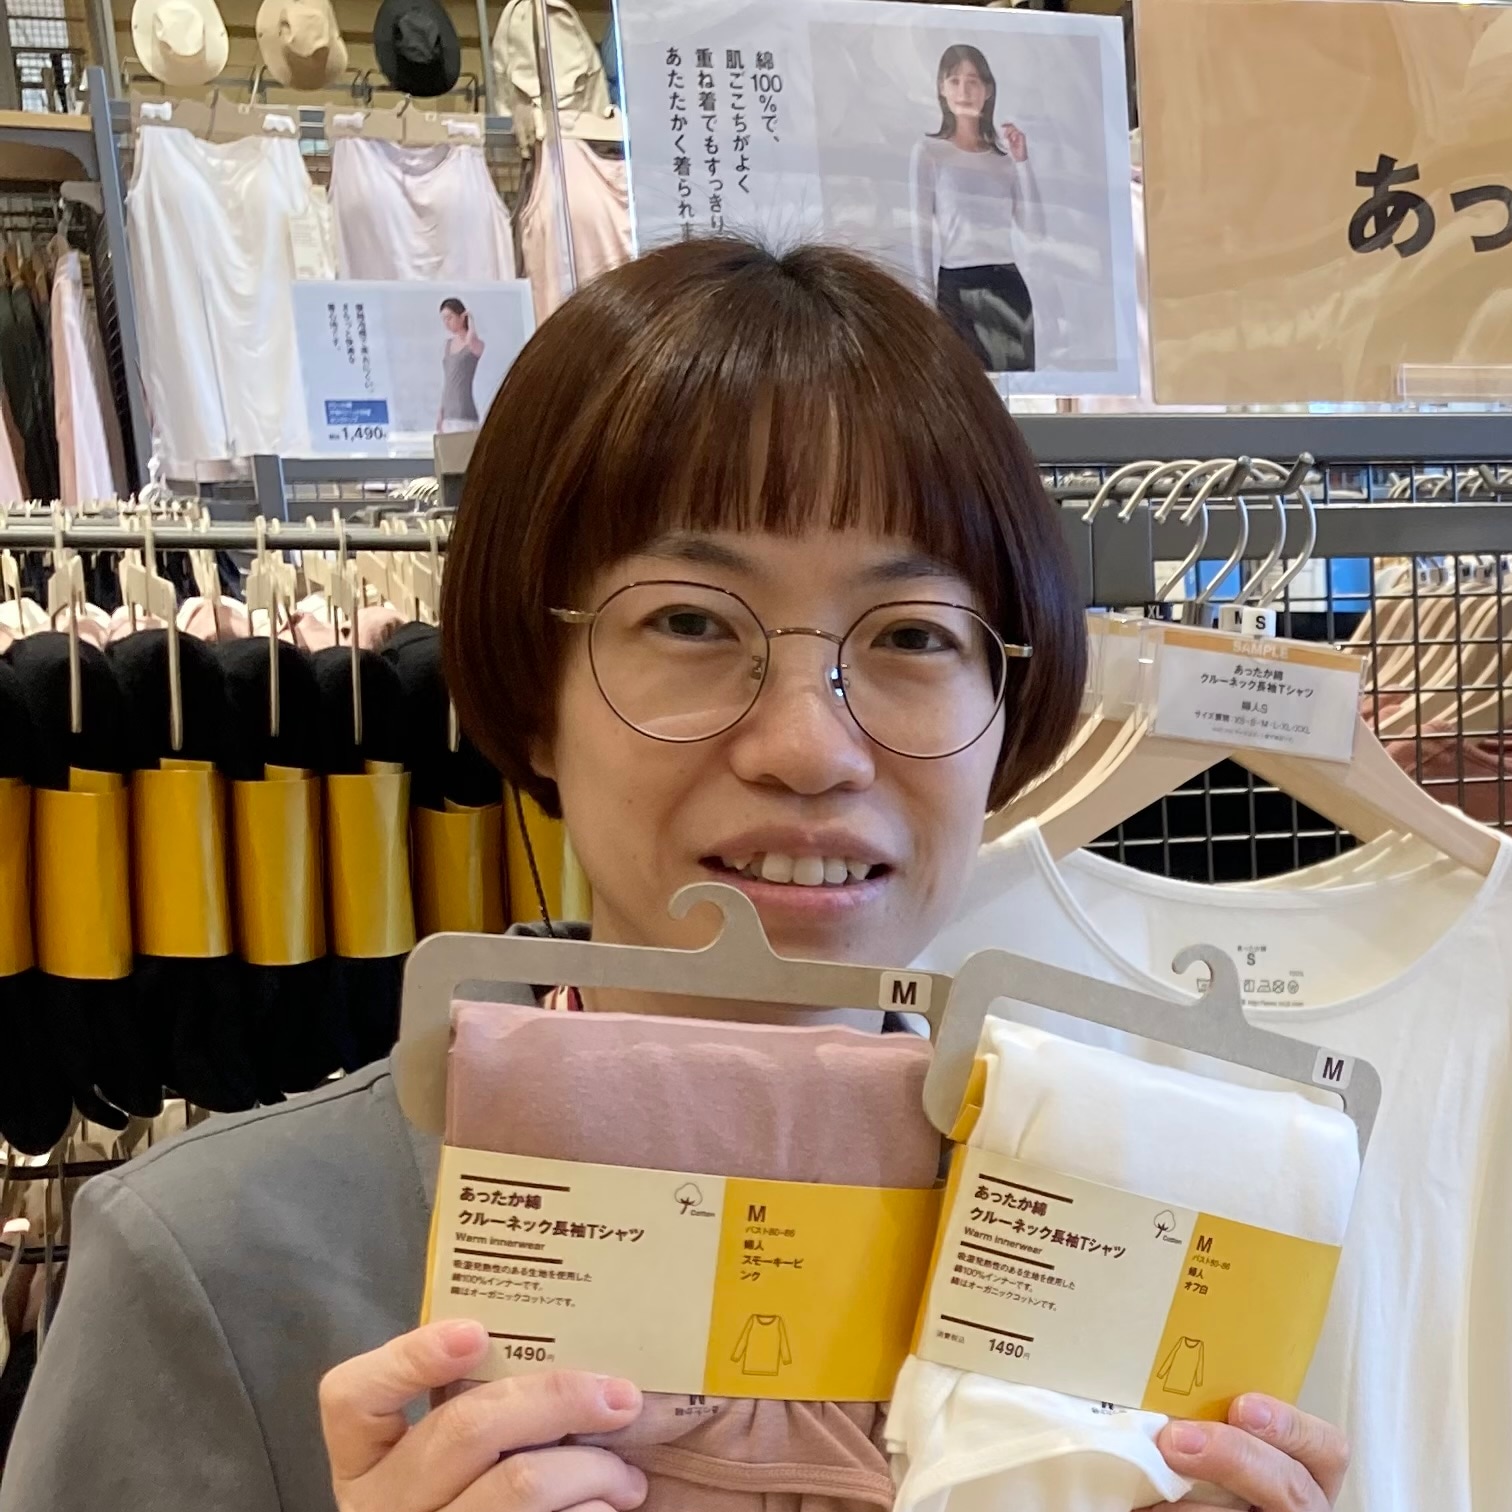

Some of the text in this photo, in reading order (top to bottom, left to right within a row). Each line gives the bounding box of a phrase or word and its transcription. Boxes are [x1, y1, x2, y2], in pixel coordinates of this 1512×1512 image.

[751, 51, 783, 142] 綿100%で、
[726, 49, 750, 193] 肌ごこちがよく
[1148, 604, 1163, 619] XL
[1256, 615, 1266, 630] S
[1232, 640, 1288, 658] SAMPLE
[1234, 664, 1284, 681] あったか綿
[1200, 673, 1314, 698] クルーネック長袖Tシャツ
[1247, 954, 1256, 966] S
[892, 980, 917, 1005] M
[1322, 1057, 1344, 1081] M
[460, 1186, 542, 1210] あったか綿
[974, 1184, 1048, 1217] あったか綿
[747, 1205, 766, 1222] M
[458, 1210, 645, 1242] クルーネック長袖Tシャツ
[969, 1207, 1126, 1259] クルーネック長袖Tシャツ
[455, 1231, 545, 1251] Warm innerwear
[744, 1240, 764, 1251] 婦人
[964, 1226, 1043, 1255] Warm innerwear
[1196, 1235, 1213, 1253] M
[740, 1271, 761, 1281] ンク
[1188, 1266, 1204, 1279] 婦人
[1184, 1281, 1209, 1295] オフ白
[988, 1338, 1031, 1360] 1490円
